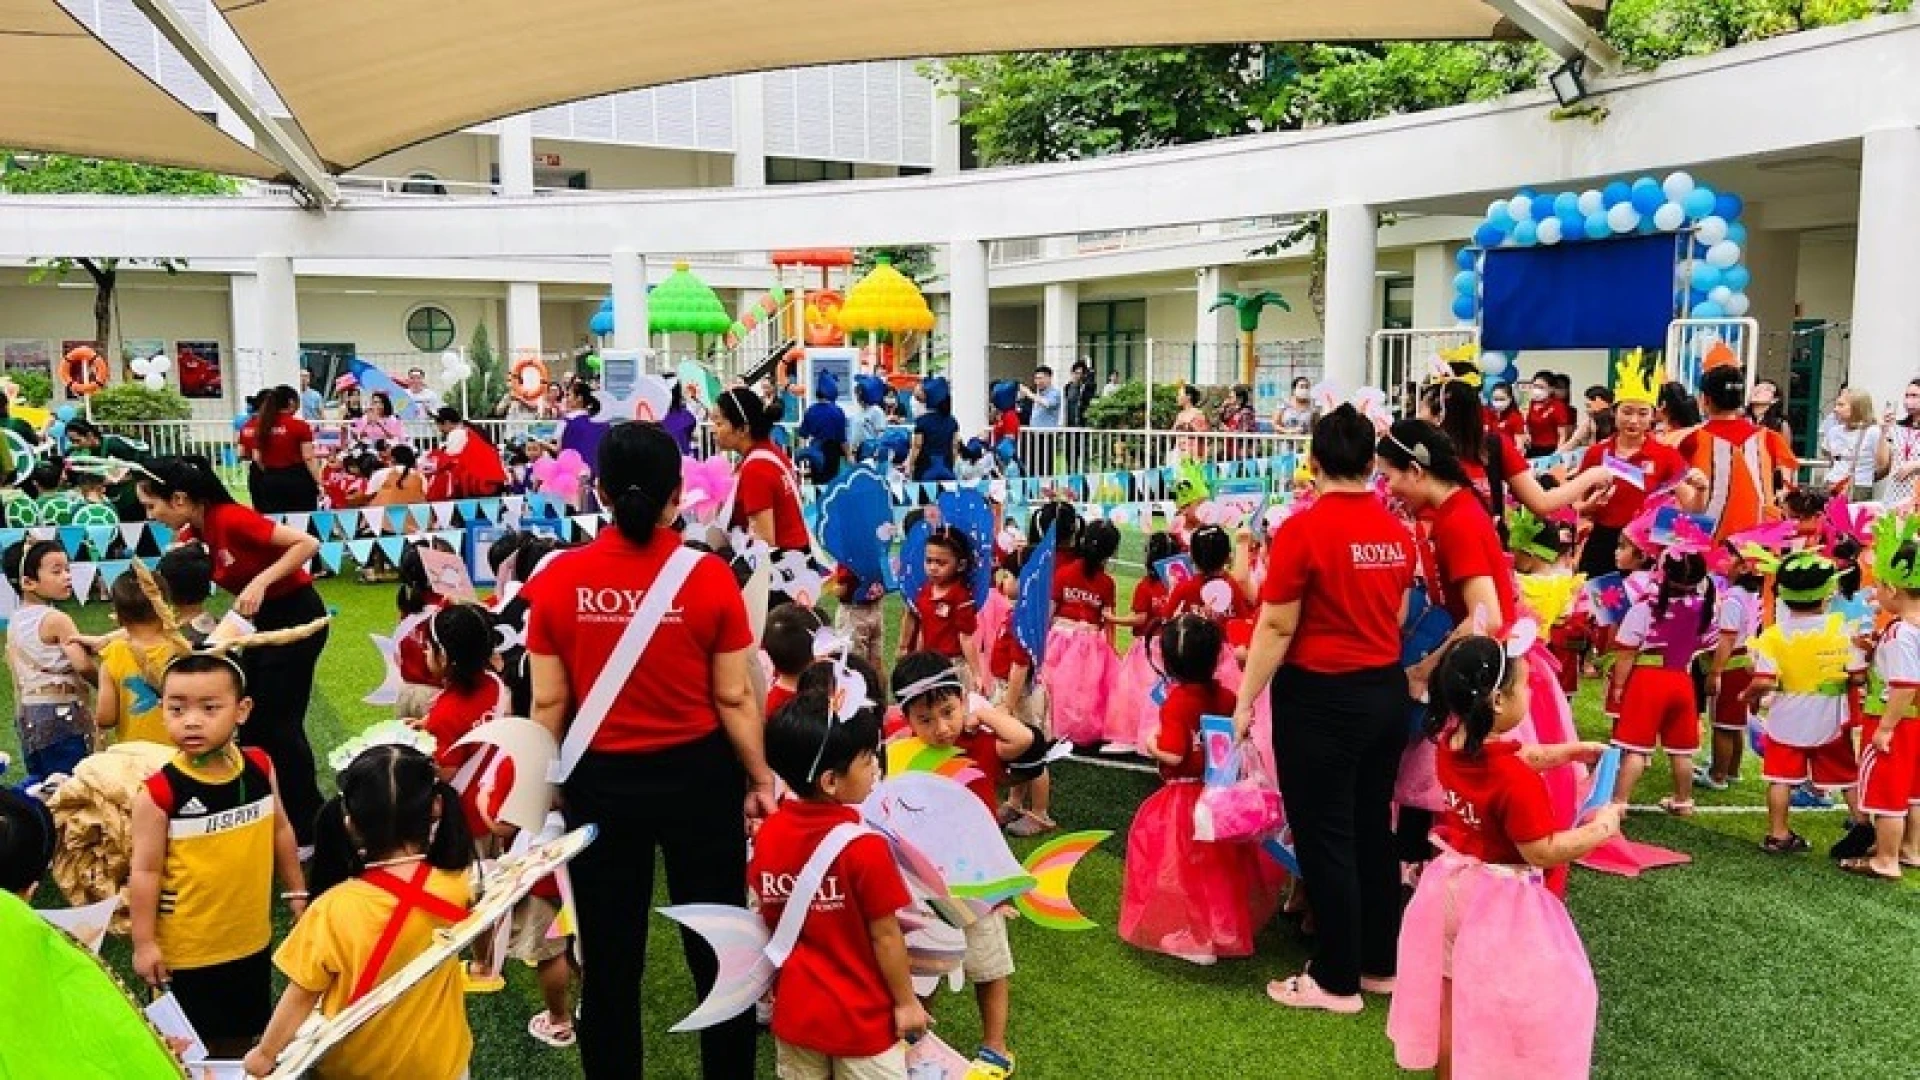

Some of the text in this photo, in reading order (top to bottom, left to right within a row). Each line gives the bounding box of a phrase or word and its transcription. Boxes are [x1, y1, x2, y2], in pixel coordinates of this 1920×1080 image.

[1349, 541, 1406, 562] ROYAL
[576, 587, 684, 613] ROYL
[760, 871, 845, 901] ROL
